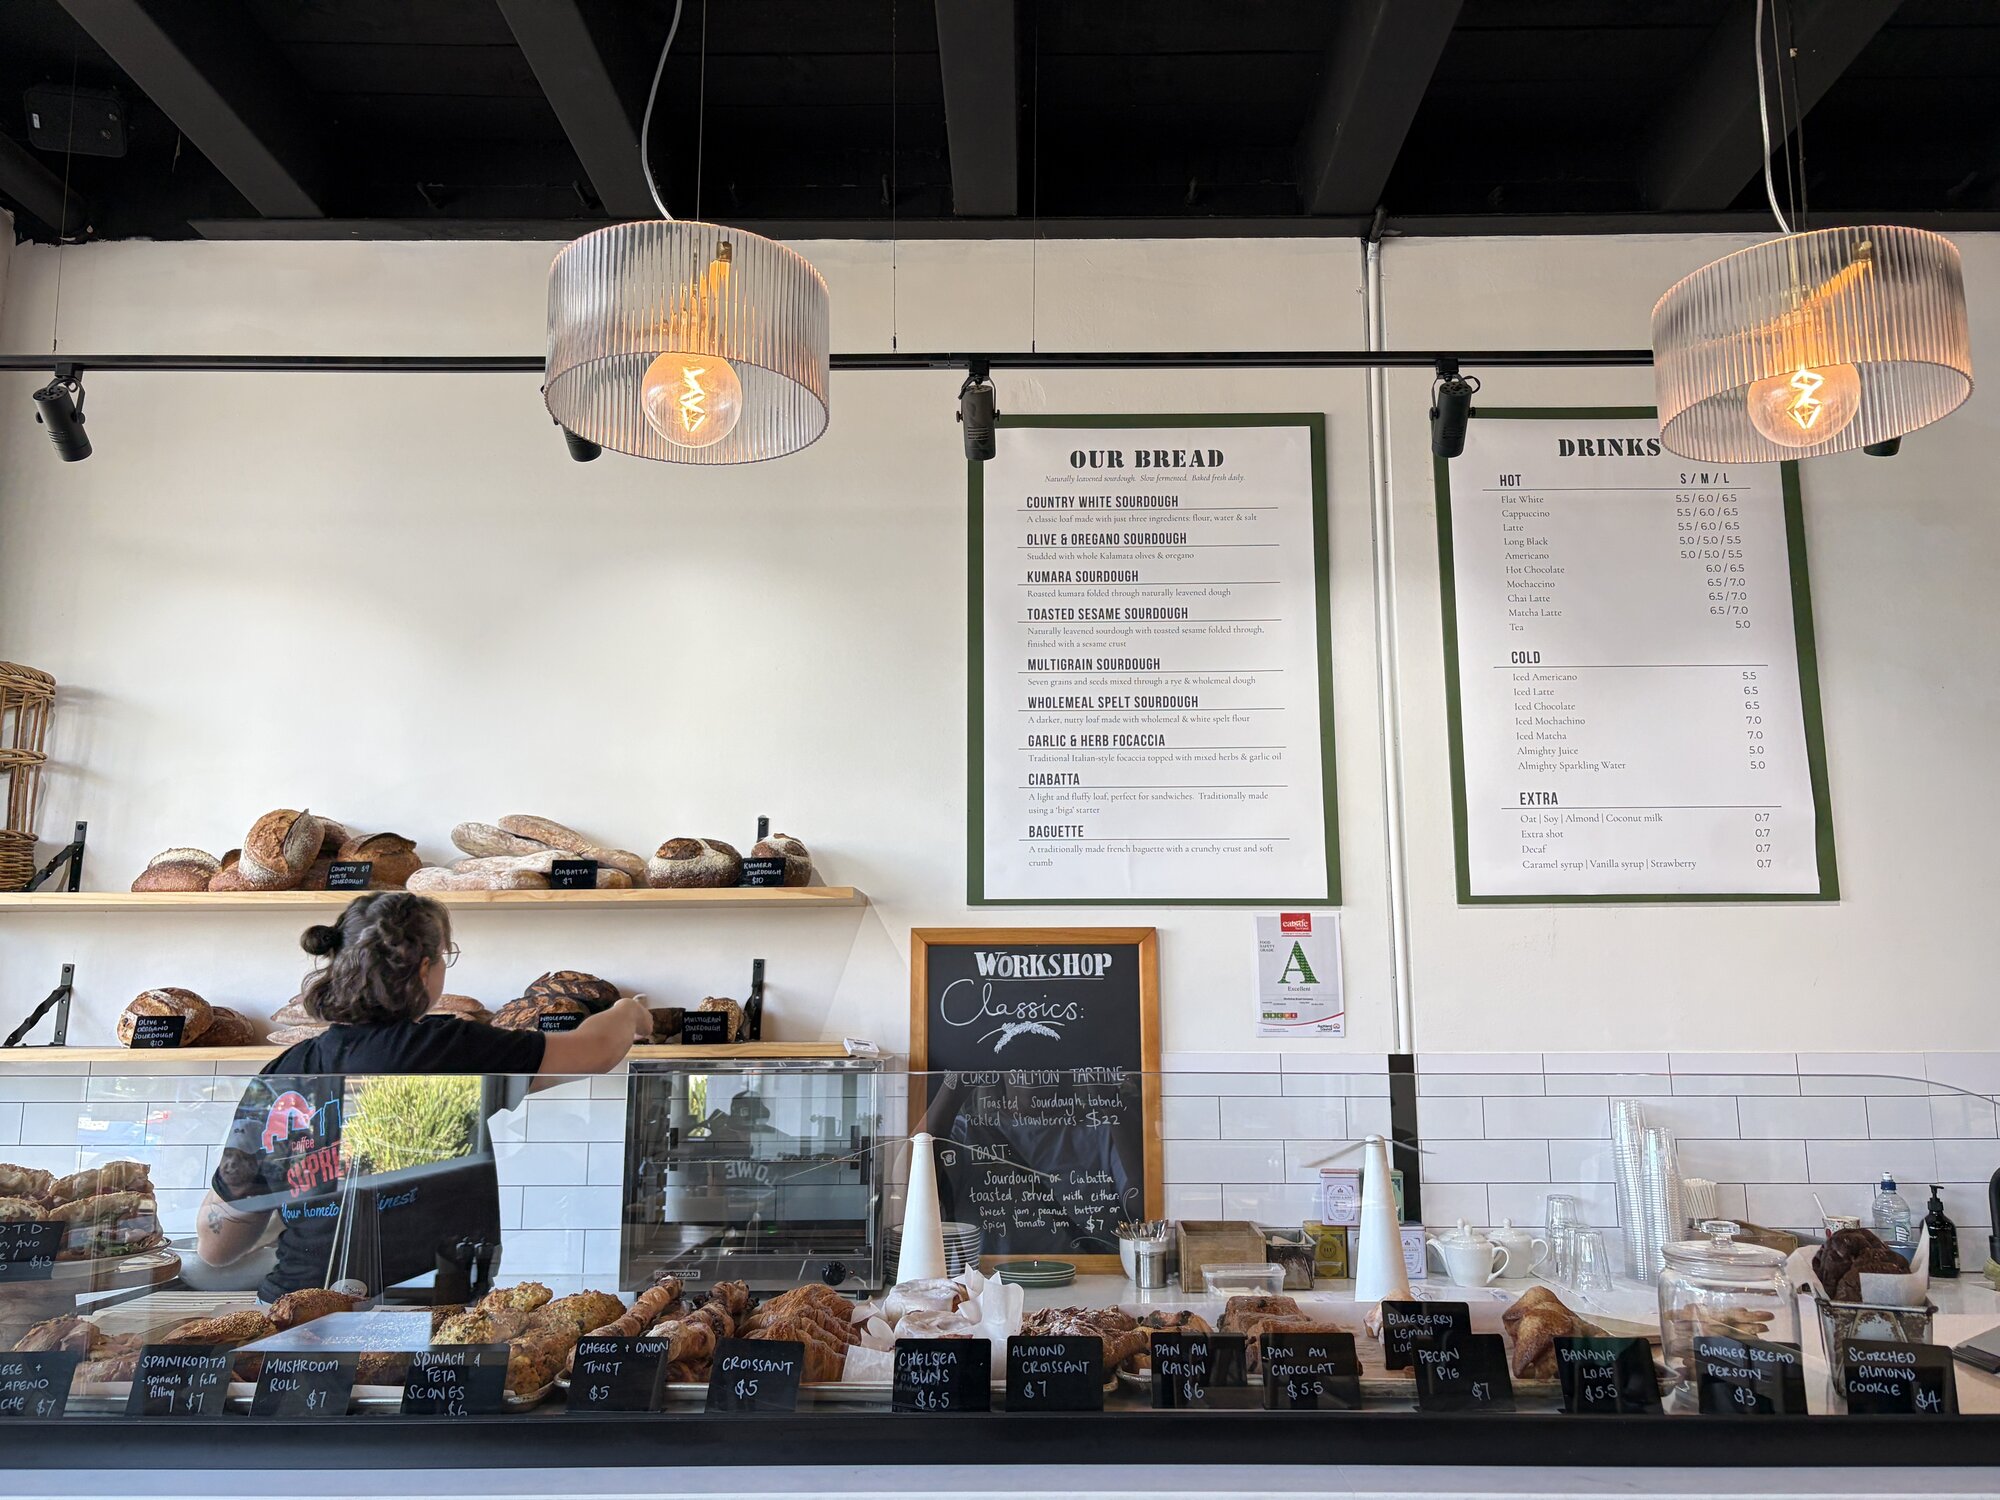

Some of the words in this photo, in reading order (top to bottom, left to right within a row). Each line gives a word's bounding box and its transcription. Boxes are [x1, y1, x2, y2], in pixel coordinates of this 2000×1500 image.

[1558, 438, 1661, 457] DRINKS
[1070, 450, 1124, 468] OUR
[1135, 450, 1223, 468] BREAD
[1500, 474, 1521, 486] HOT
[1027, 496, 1074, 508] COUNTRY
[1079, 496, 1112, 508] WHITE
[1116, 496, 1178, 507] SOURDOUGH
[1519, 495, 1544, 503] White
[1502, 510, 1550, 520] Cappuccino
[1027, 534, 1056, 545] OLIVE
[1061, 534, 1067, 545] &
[1072, 533, 1119, 545] OREGANO
[1124, 533, 1186, 544] SOURDOUGH
[1504, 538, 1524, 548] Long
[1527, 537, 1548, 545] Black
[1028, 571, 1071, 582] KUMARA
[1076, 570, 1138, 582] SOURDOUGH
[1506, 566, 1522, 574] Hot
[1507, 580, 1555, 588] Mochaccino
[1112, 589, 1139, 598] through
[1142, 589, 1173, 598] naturally
[1176, 588, 1206, 596] leavened
[1209, 588, 1230, 598] dough
[1027, 608, 1074, 620] TOASTED
[1078, 608, 1120, 620] SESAME
[1125, 608, 1188, 619] SOURDOUGH
[1028, 659, 1092, 670] MULTIGRAIN
[1097, 658, 1160, 670] SOURDOUGH
[1512, 651, 1540, 664] COLD
[1513, 673, 1530, 681] Iced
[1743, 672, 1756, 680] 5.5
[1028, 697, 1094, 708] WHOLEMEAL
[1098, 696, 1130, 708] SPELT
[1134, 696, 1198, 708] SOURDOUGH
[1515, 702, 1532, 710] Iced
[1534, 702, 1575, 710] Chocolate
[1745, 701, 1759, 709] 6.5
[1516, 717, 1532, 725] Iced
[1536, 716, 1585, 725] Mochachino
[1746, 716, 1761, 724] 7.0
[1028, 735, 1066, 747] GARLIC
[1070, 735, 1076, 746] &
[1081, 735, 1108, 746] HERB
[1113, 734, 1165, 746] FOCACCIA
[1518, 746, 1556, 757] Almighty
[1558, 747, 1578, 757] Juice
[1750, 746, 1764, 754] 5.0
[1518, 761, 1557, 772] Almighty
[1560, 761, 1599, 772] Sparkling
[1601, 761, 1626, 769] Water
[1751, 761, 1765, 769] 5.0
[1029, 773, 1080, 785] CIABATTA
[1520, 792, 1558, 805] EXTRA
[1755, 813, 1770, 822] 0.7
[1029, 826, 1083, 837] BAGUETTE
[1522, 830, 1543, 838] Extra
[1546, 829, 1563, 838] shot
[1522, 844, 1547, 853] Decaf
[1757, 860, 1771, 868] 0.7
[974, 951, 1113, 977] WORKSHOP
[1278, 940, 1320, 984] A
[940, 978, 1085, 1027] Classics:
[961, 1073, 1000, 1084] CURED
[1008, 1069, 1060, 1085] SALMON
[979, 1096, 1018, 1110] Toasted
[966, 1114, 1000, 1126] Pickled
[1085, 1109, 1120, 1130] $22
[291, 1136, 315, 1151] coffee
[984, 1170, 1040, 1193] Sourdough
[1070, 1170, 1114, 1184] Ciabatta
[1022, 1188, 1054, 1201] served
[1063, 1190, 1083, 1201] with
[1038, 1208, 1067, 1219] peanut
[1074, 1205, 1104, 1215] butter
[1015, 1220, 1045, 1228] tomato
[1051, 1220, 1070, 1234] jam
[1086, 1216, 1104, 1233] $7
[30, 1254, 52, 1269] $13
[1387, 1313, 1453, 1327] BLUEBERRY
[579, 1342, 618, 1355] CHEESE
[635, 1340, 669, 1354] ONION
[1012, 1344, 1065, 1357] ALMOND
[1155, 1343, 1180, 1358] PAN
[1191, 1343, 1208, 1357] AU
[1267, 1346, 1294, 1359] PAN
[1308, 1347, 1327, 1358] AU
[141, 1355, 226, 1368] SPANIKOPITA
[413, 1350, 465, 1367] SPINACH
[899, 1352, 957, 1367] CHELSEA
[1418, 1347, 1460, 1364] PECAN
[1560, 1348, 1616, 1362] BANANA
[1849, 1347, 1916, 1363] SCORCHED
[265, 1359, 339, 1375] MUSHROOM
[583, 1360, 622, 1375] TWIST
[722, 1356, 794, 1375] CROISSANT
[1022, 1360, 1090, 1375] CROISSANT
[1162, 1361, 1206, 1376] RAISIN
[1272, 1363, 1335, 1376] CHOCOLAT
[1583, 1366, 1614, 1379] LOAF
[1707, 1363, 1762, 1379] PERSON
[426, 1367, 456, 1383] FETA
[911, 1369, 950, 1385] BUNS
[1859, 1365, 1916, 1381] ALMOND
[270, 1377, 300, 1393] ROLL
[734, 1379, 759, 1399] $5
[1023, 1381, 1047, 1399] $7
[1183, 1383, 1204, 1400] $6
[1287, 1380, 1324, 1400] $5.5
[1471, 1381, 1490, 1400] $7
[1849, 1380, 1901, 1396] COOKIE
[407, 1385, 465, 1400] SCONES
[589, 1385, 610, 1401] $5
[1585, 1385, 1618, 1403] $5.5
[1734, 1386, 1756, 1406] $3
[186, 1392, 204, 1413] $7
[306, 1391, 327, 1410] $7
[915, 1392, 950, 1409] $6.5
[1915, 1388, 1940, 1413] $4
